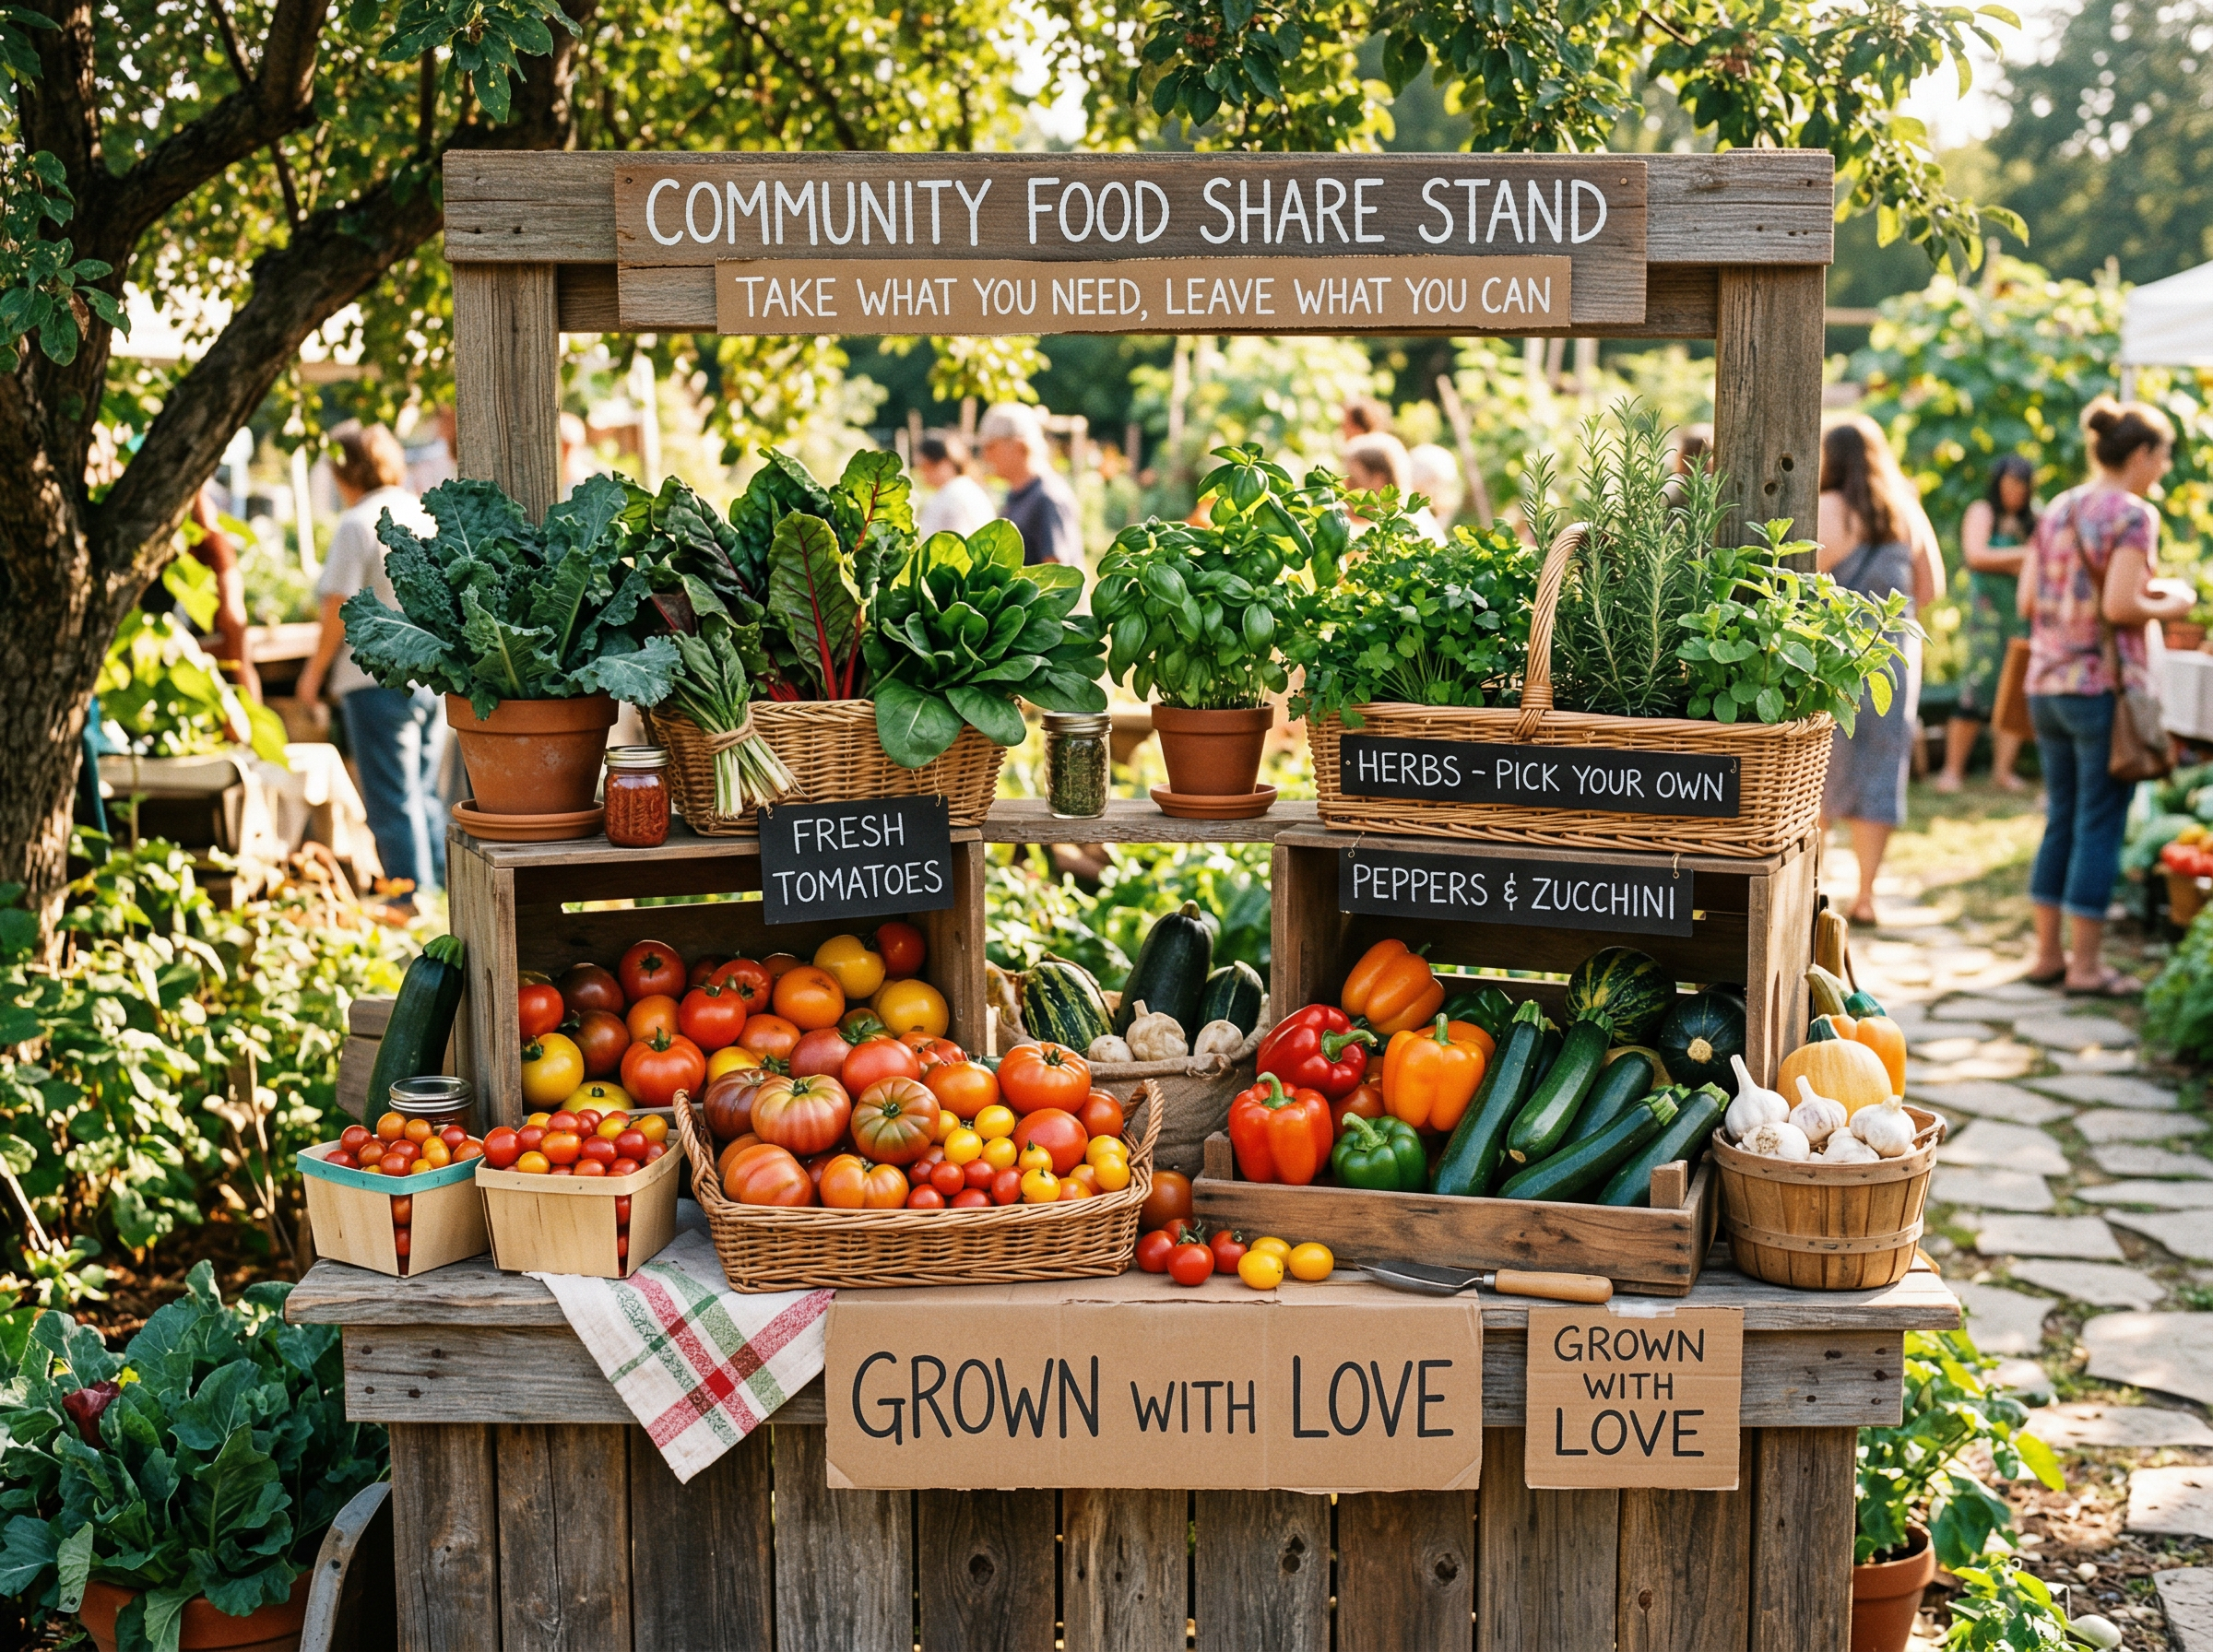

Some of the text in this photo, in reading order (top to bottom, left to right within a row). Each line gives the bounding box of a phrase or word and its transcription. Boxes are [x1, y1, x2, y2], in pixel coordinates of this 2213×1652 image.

[645, 177, 1607, 247] COMMUNITY FOOD SHARE STAND
[735, 276, 1551, 322] TAKE WHAT YOU NEED, LEAVE WHAT YOU CAN
[1358, 749, 1462, 787] HERBS
[1496, 759, 1560, 792] PICK
[1571, 764, 1645, 798] YOUR
[1656, 771, 1723, 802] OWN
[793, 812, 905, 855] FRESH
[772, 859, 943, 906] TOMATOES
[1353, 863, 1675, 920] PEPPERS & ZUCCHINI
[1554, 1325, 1704, 1363] GROWN
[852, 1351, 1454, 1446] GROWN WITH LOVE
[1582, 1372, 1674, 1400] WITH
[1556, 1407, 1705, 1457] LOVE
